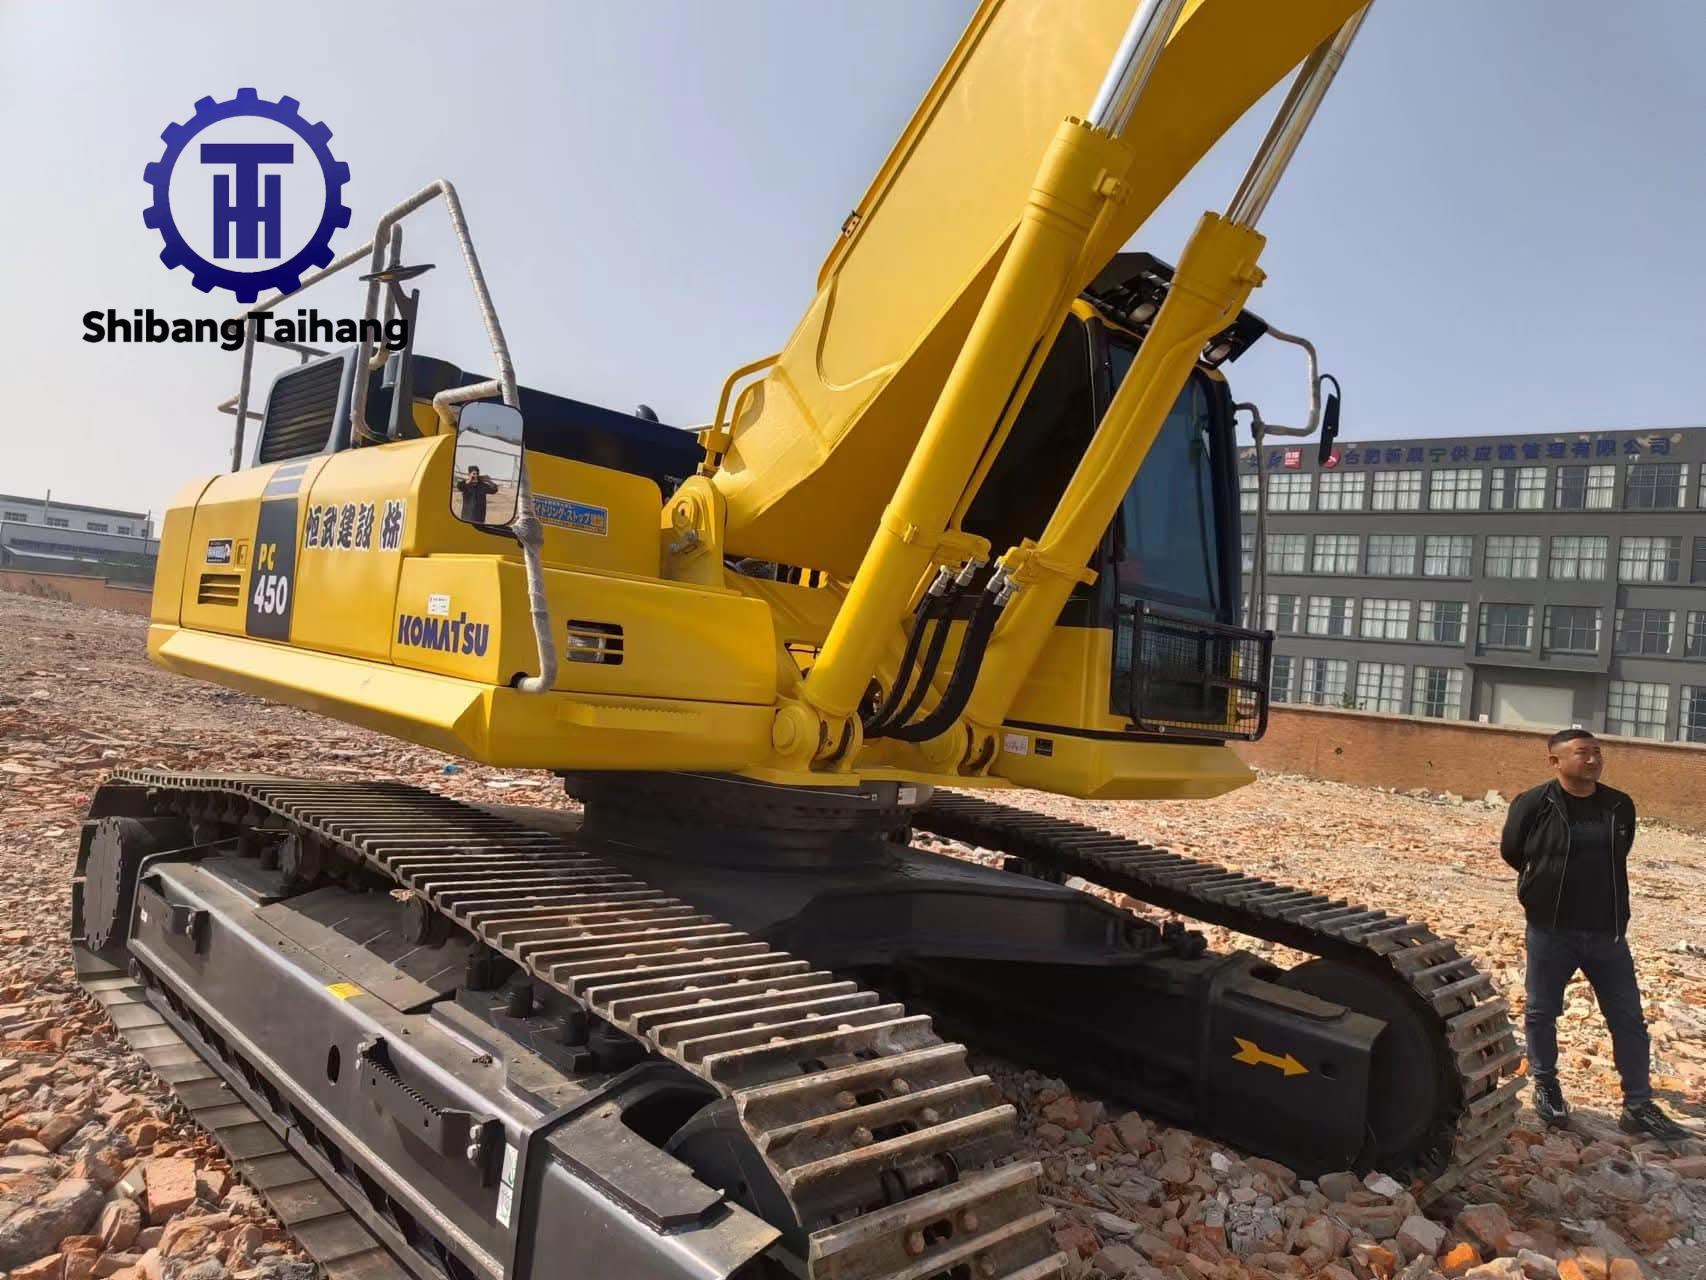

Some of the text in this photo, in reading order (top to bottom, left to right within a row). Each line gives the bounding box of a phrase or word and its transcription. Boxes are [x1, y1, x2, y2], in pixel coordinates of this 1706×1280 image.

[258, 543, 277, 571] PC
[253, 574, 288, 615] 450
[397, 612, 489, 657] KOMATSU
